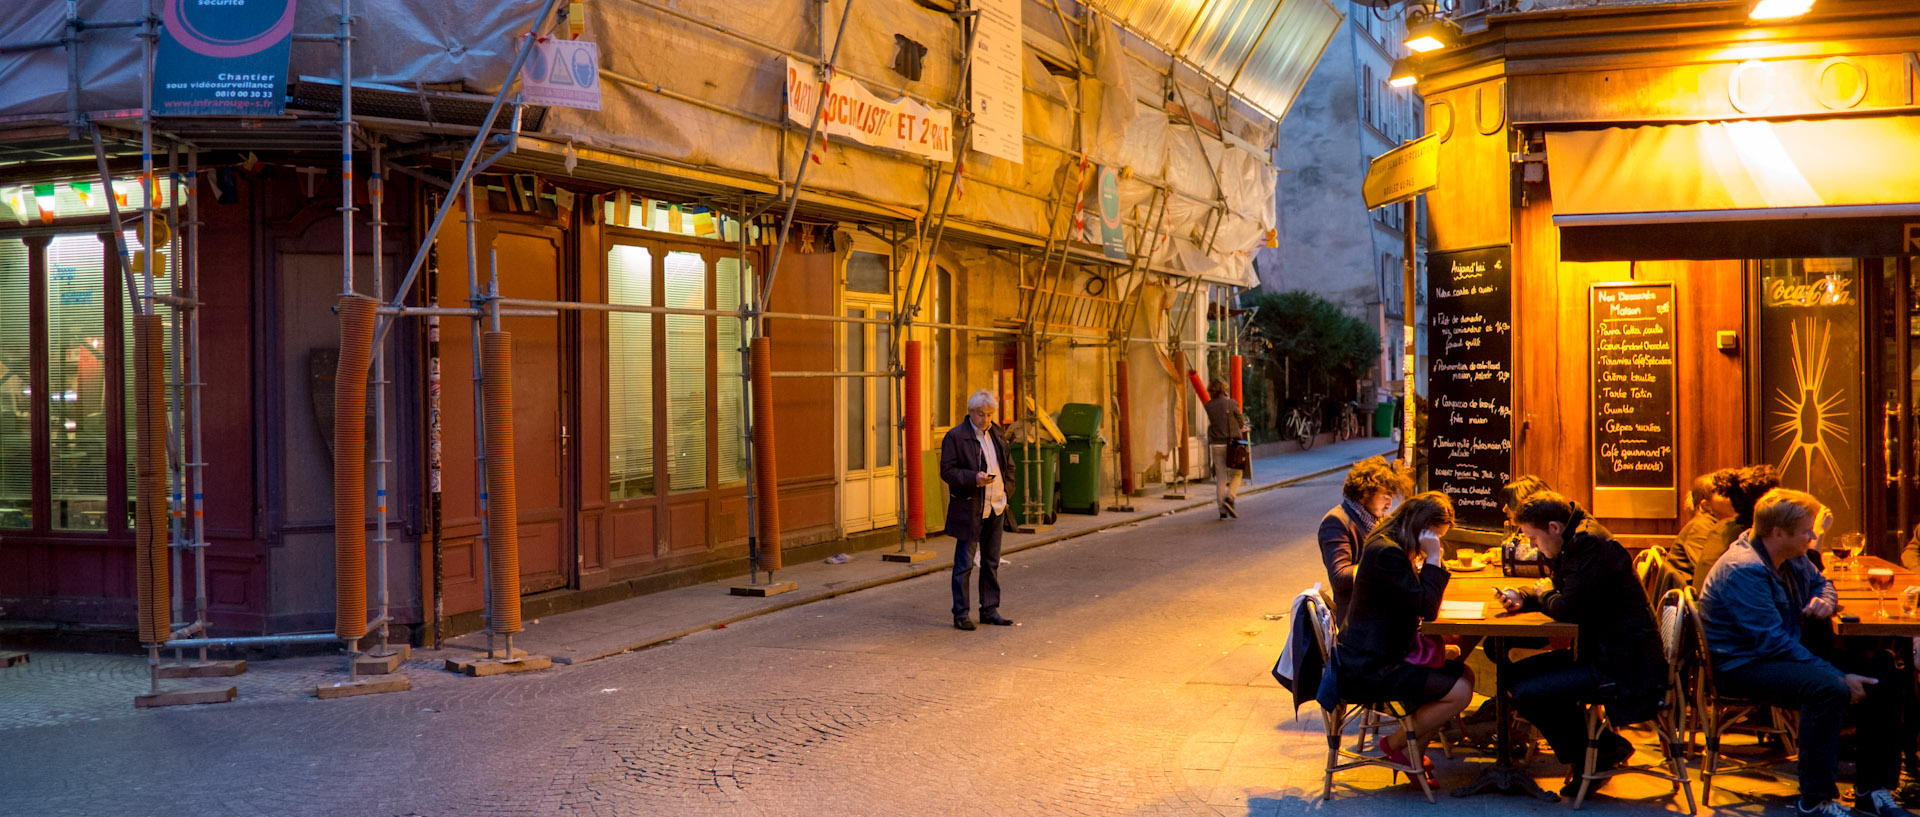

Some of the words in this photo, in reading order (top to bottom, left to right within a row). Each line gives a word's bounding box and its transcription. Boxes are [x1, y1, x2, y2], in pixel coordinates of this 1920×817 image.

[218, 73, 275, 81] Chantier
[190, 81, 274, 89] vidéosurveillance
[1424, 82, 1506, 145] DU
[1610, 304, 1641, 316] Maison
[1602, 387, 1628, 398] Tarte
[1630, 387, 1653, 398] Tatin
[1603, 402, 1635, 415] Crumble
[1601, 443, 1620, 463] Café
[1620, 447, 1660, 460] gourmand
